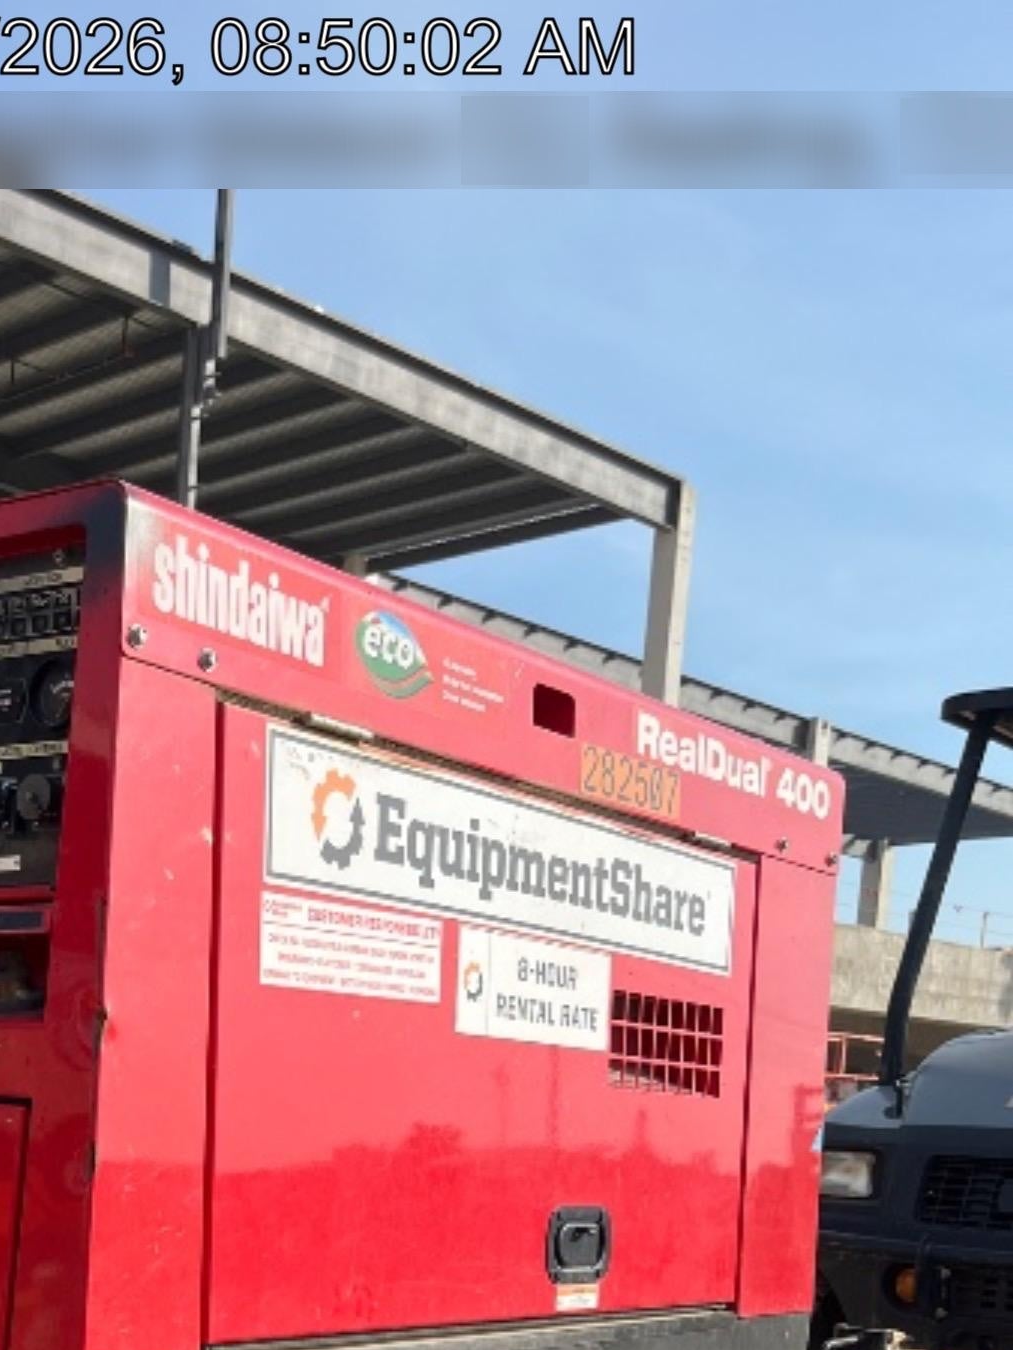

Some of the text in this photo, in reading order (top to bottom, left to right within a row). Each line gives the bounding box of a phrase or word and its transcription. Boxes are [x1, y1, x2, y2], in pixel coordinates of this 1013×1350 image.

[153, 534, 325, 668] shindaiwa
[363, 624, 416, 669] eco
[583, 746, 680, 815] 282507
[638, 713, 830, 820] RealDual 400
[374, 791, 706, 937] EquipmentShare
[496, 992, 599, 1032] RENTAL RATE
